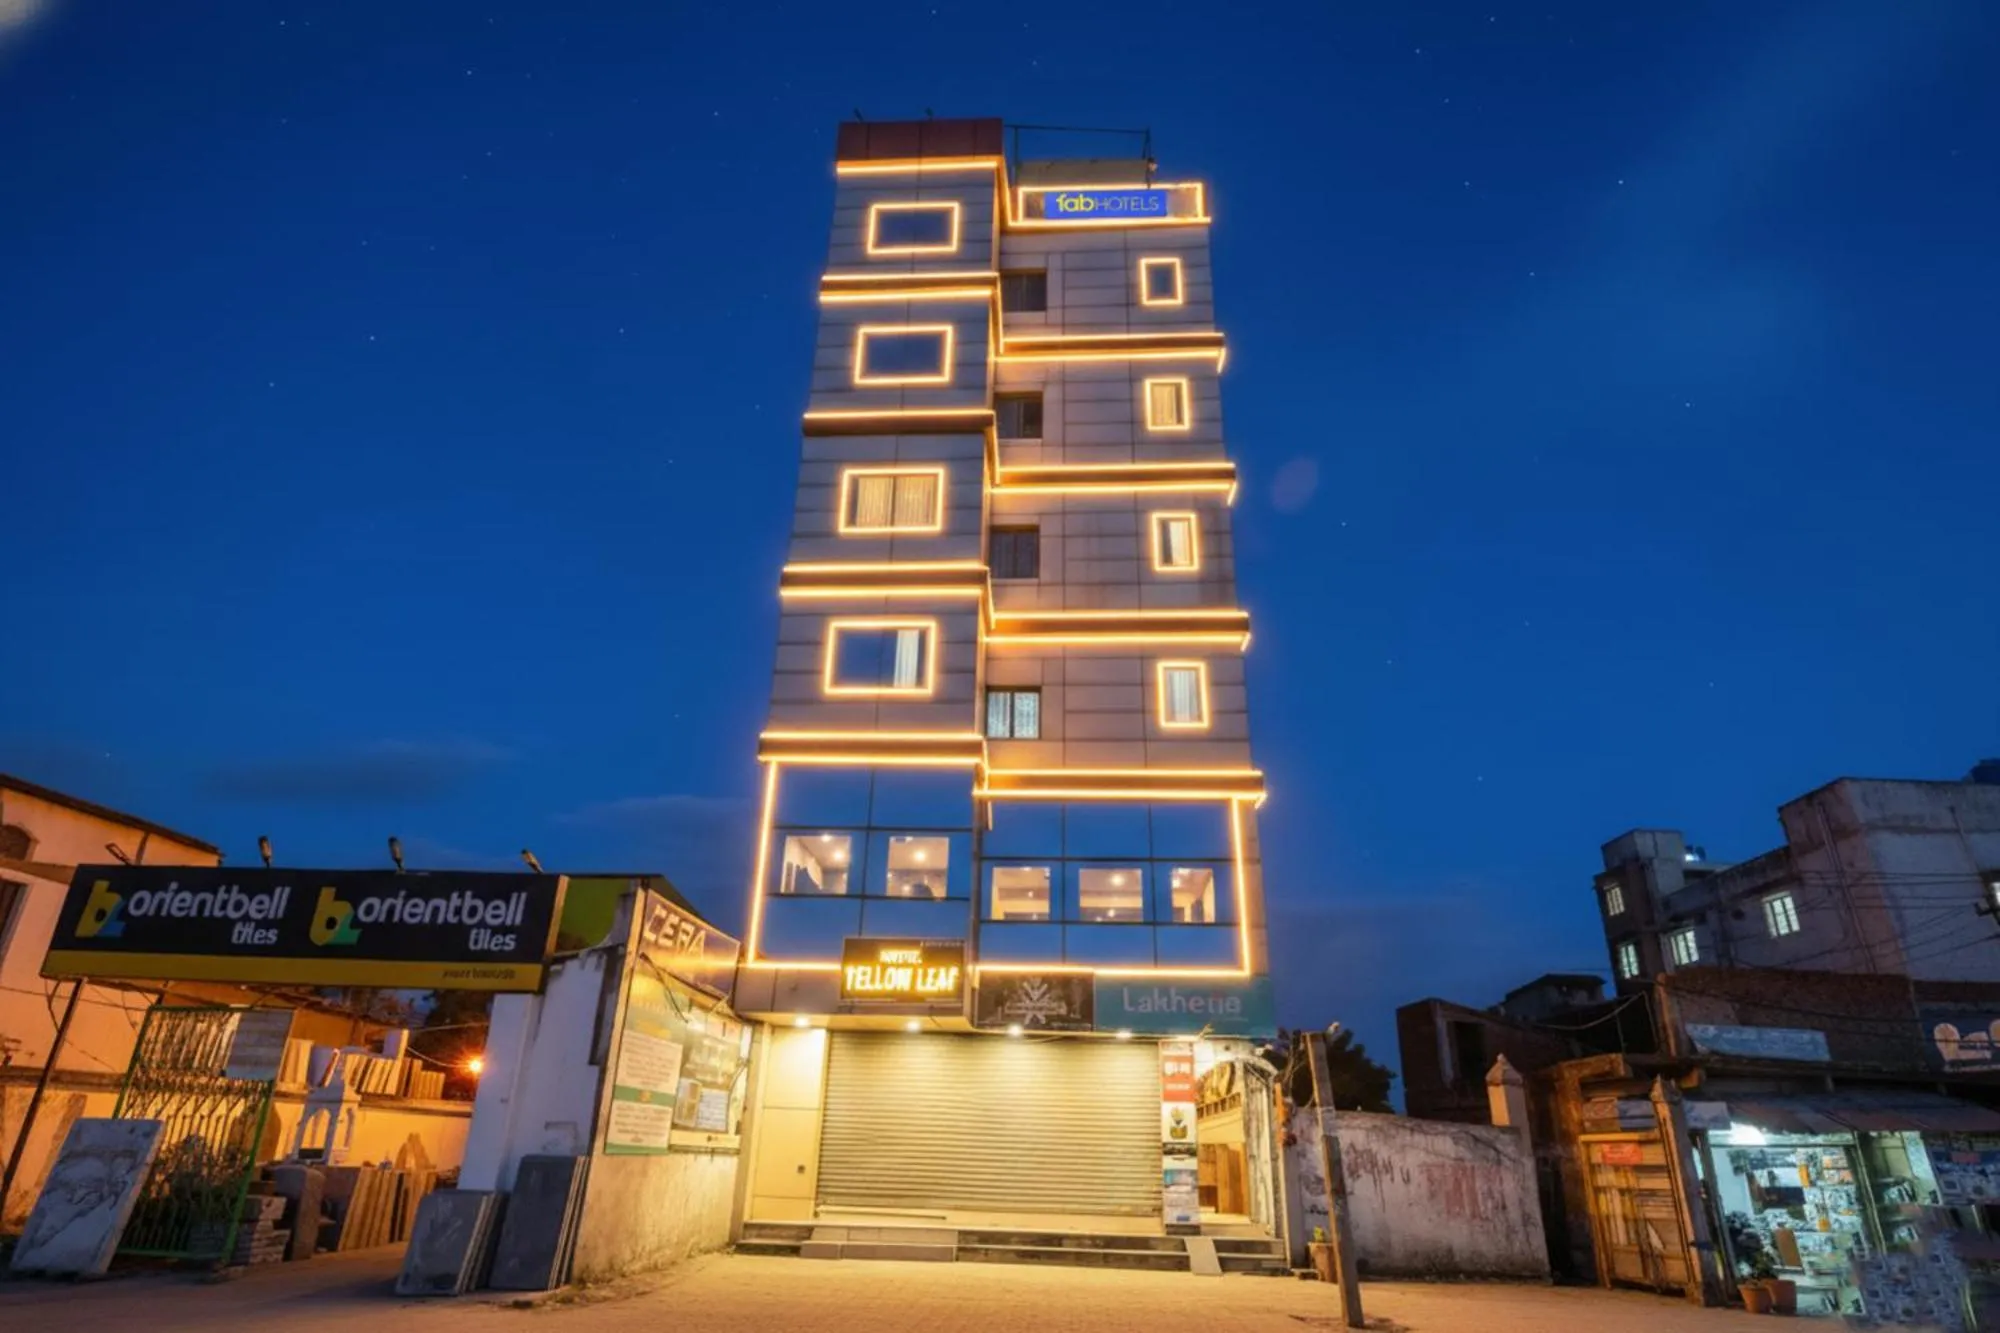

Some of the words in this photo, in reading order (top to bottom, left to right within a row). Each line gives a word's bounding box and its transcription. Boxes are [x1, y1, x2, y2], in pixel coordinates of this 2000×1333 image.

[127, 881, 292, 920] orientbell
[356, 890, 528, 926] orientbell
[231, 921, 279, 945] tiles
[468, 928, 517, 951] tiles
[643, 903, 706, 961] CERA
[916, 965, 960, 993] LEAF
